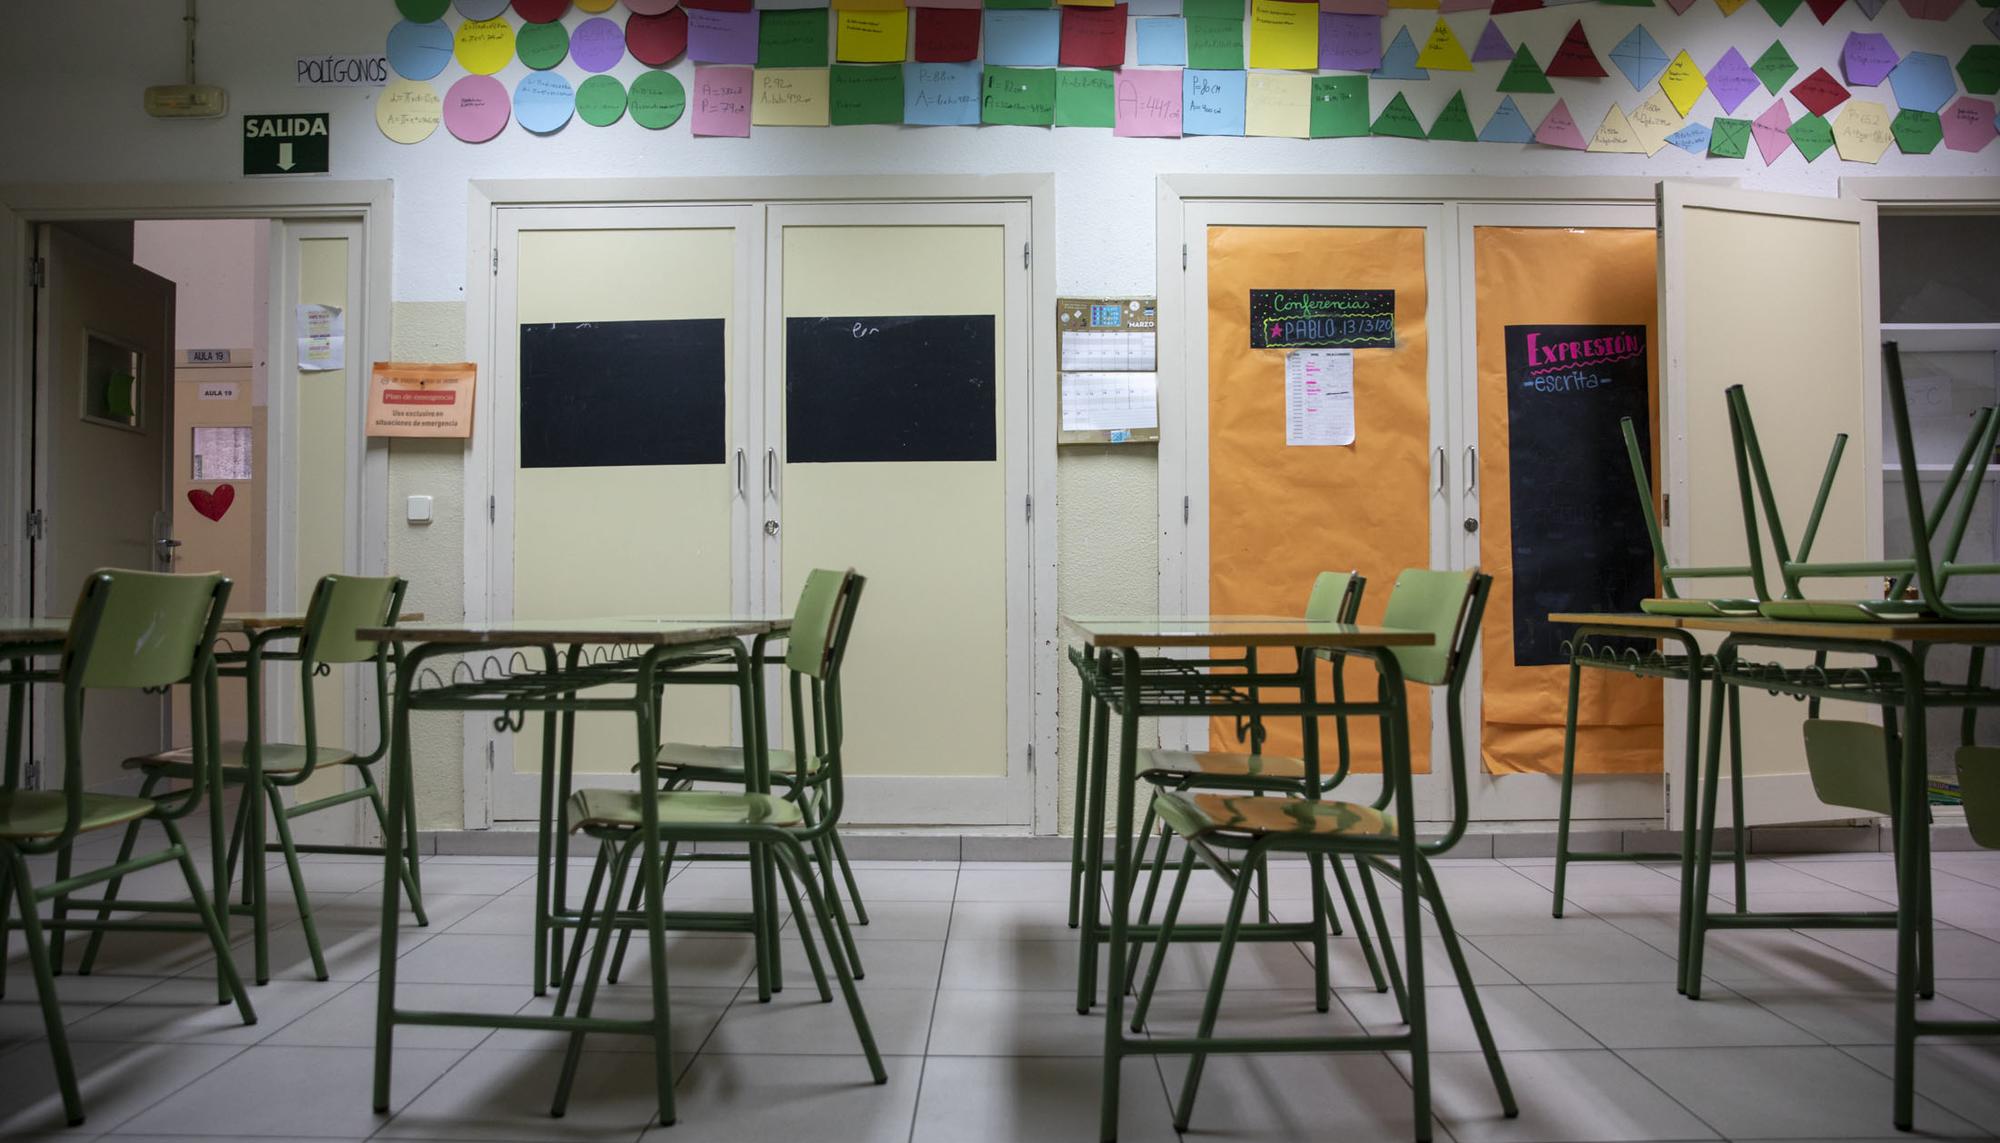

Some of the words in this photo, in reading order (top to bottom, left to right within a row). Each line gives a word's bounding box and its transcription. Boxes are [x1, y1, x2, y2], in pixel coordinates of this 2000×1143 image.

[297, 56, 387, 83] POLÍGONOS
[246, 117, 328, 138] SALIDA
[1274, 293, 1370, 319] Conferencias
[1285, 319, 1335, 341] PABLO
[193, 352, 213, 361] AULA
[215, 352, 224, 361] 19
[385, 392, 401, 400] Plan
[375, 419, 412, 427] situaciones
[421, 420, 458, 428] emergencia
